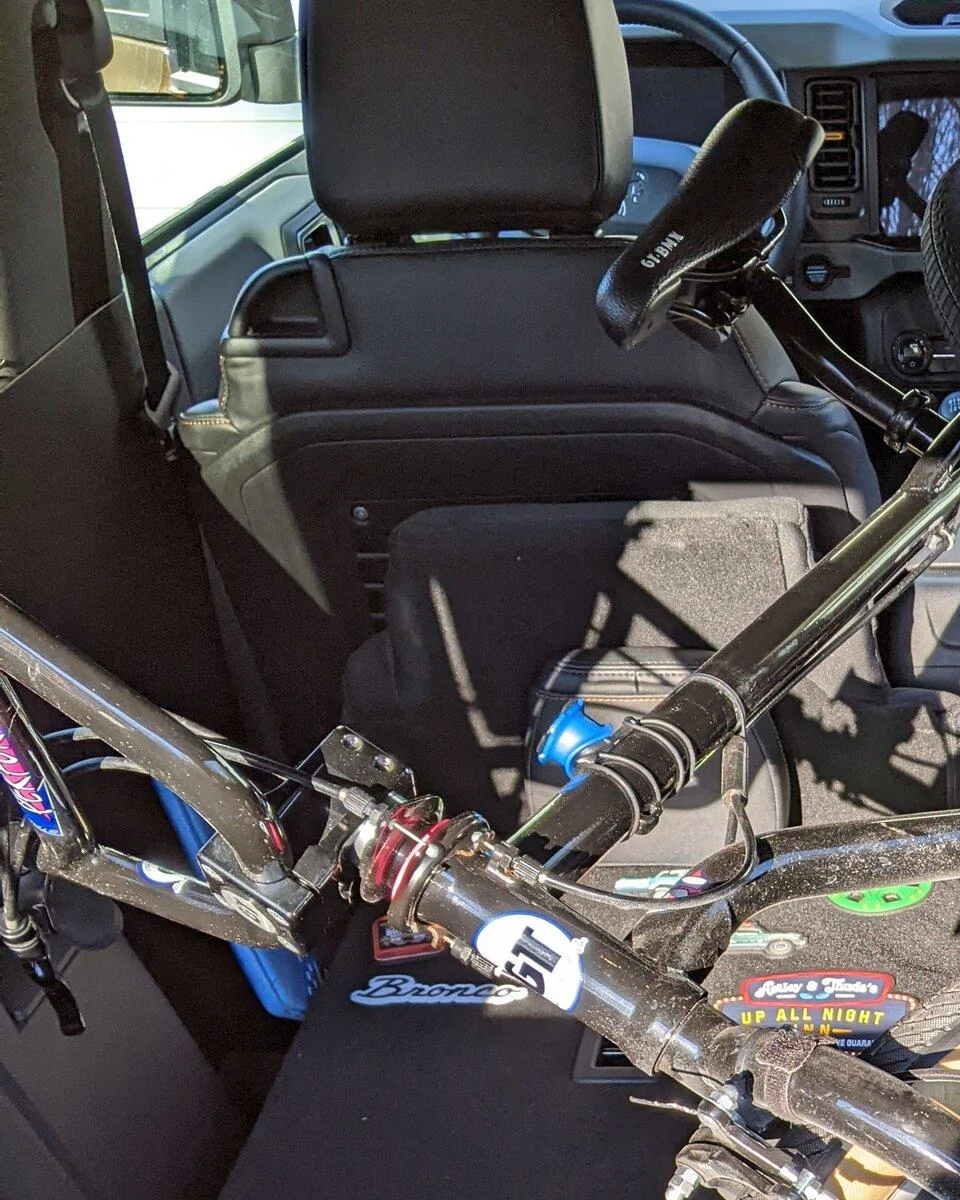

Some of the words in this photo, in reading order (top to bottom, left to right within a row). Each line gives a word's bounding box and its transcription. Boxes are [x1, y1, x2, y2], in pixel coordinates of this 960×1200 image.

[504, 925, 562, 996] GT
[354, 974, 527, 1003] Bronco
[741, 1011, 766, 1025] UP
[776, 1008, 812, 1022] ALL
[822, 1009, 884, 1025] NIGHT
